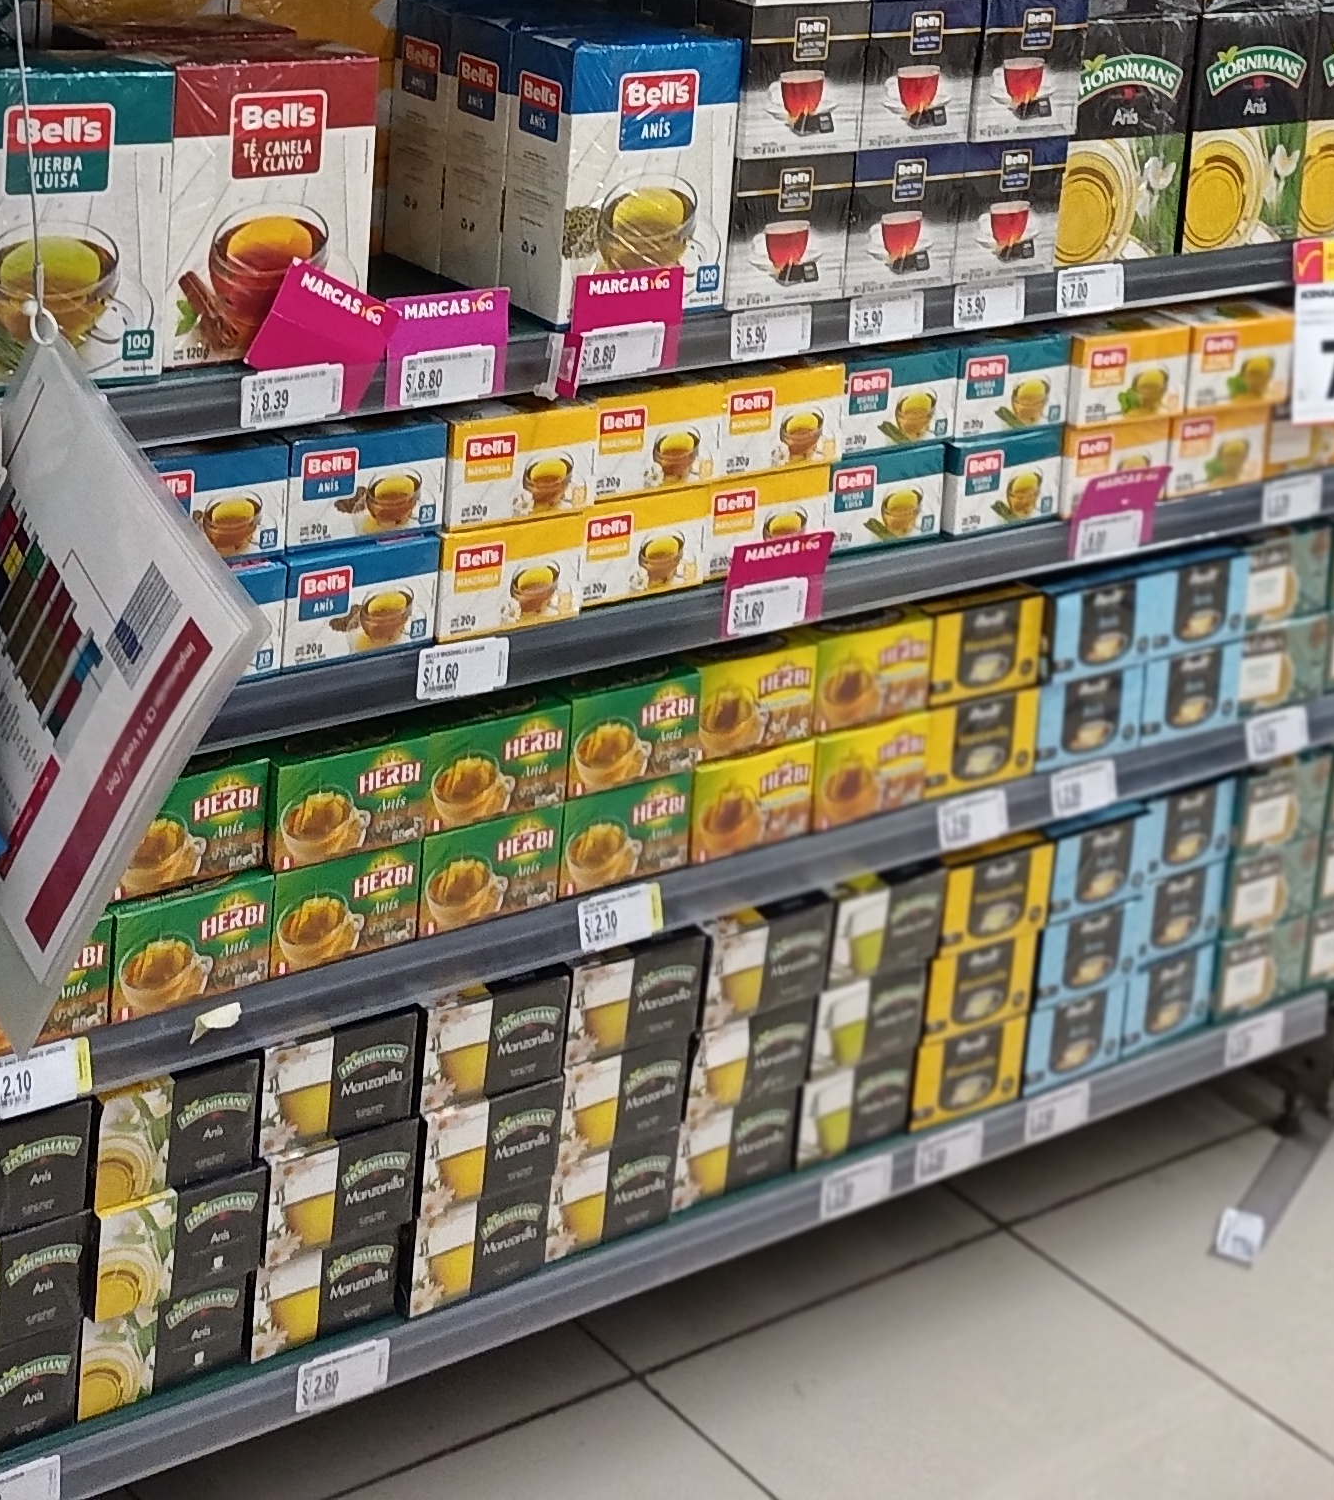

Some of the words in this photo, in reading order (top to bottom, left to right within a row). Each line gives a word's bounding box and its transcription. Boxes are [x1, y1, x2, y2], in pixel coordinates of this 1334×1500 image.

[1079, 59, 1179, 96] HORNIMANS
[1213, 55, 1302, 88] HORNIMANS
[627, 80, 690, 107] Bell's
[241, 103, 317, 131] Bell's
[1111, 107, 1139, 126] Anís
[1242, 98, 1268, 115] Anís
[16, 116, 103, 144] Bell's
[529, 112, 547, 130] ANÍS
[641, 118, 671, 140] ANÍS
[264, 139, 313, 157] CANELA
[250, 157, 259, 173] Y
[262, 156, 304, 172] CLAVO
[35, 172, 79, 188] LUISA
[699, 269, 717, 283] 100
[300, 273, 363, 315] MARCAS
[404, 301, 470, 320] MARCAS
[125, 334, 151, 349] 100
[186, 346, 210, 361] 120g
[602, 411, 643, 432] Bell's
[468, 437, 513, 458] Bell's
[306, 453, 354, 476] Bell's
[317, 477, 340, 495] ANÍS
[419, 505, 435, 522] 20
[302, 571, 350, 595] Bell's
[313, 598, 335, 614] ANÍS
[641, 696, 696, 726] HERBI
[504, 729, 565, 761] HERBI
[359, 761, 423, 794] HERBI
[193, 786, 260, 820] HERBI
[497, 829, 556, 861] HERBI
[353, 863, 415, 897] HERBI
[201, 905, 266, 939] HERBI
[495, 1027, 555, 1058] Manzanilla
[339, 1068, 403, 1099] Manzanilla
